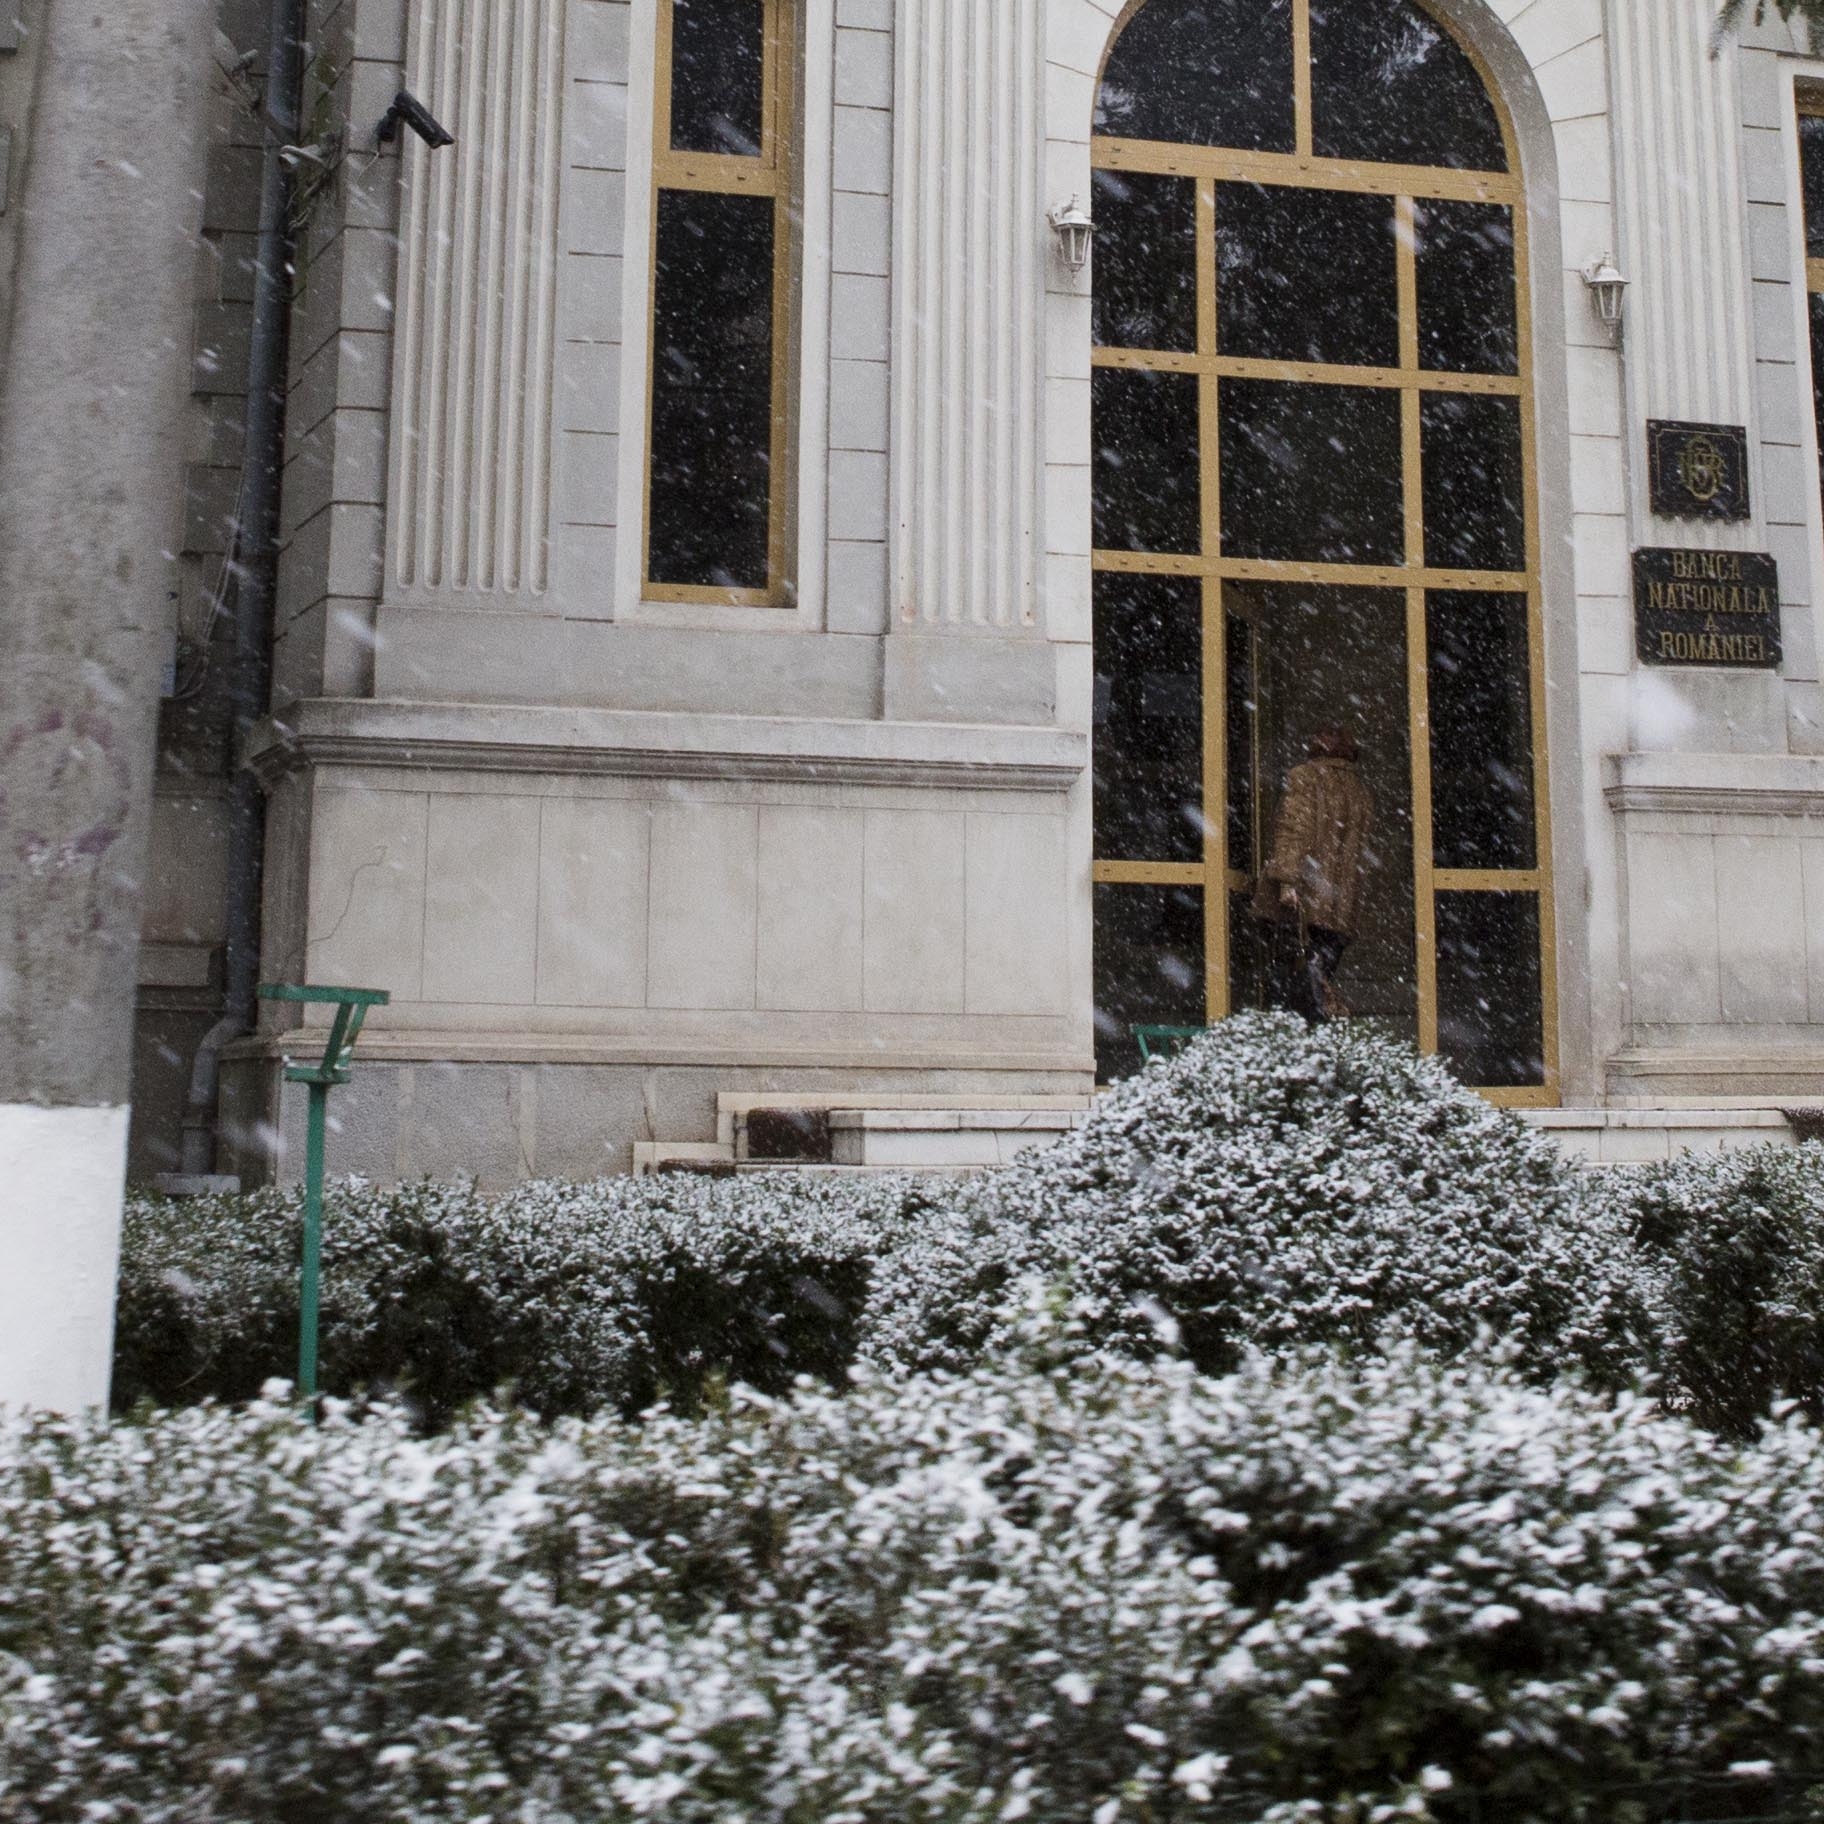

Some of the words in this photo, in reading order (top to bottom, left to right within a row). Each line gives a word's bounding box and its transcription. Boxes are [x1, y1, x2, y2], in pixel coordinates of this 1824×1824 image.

[1672, 552, 1743, 580] BANCA
[1648, 582, 1770, 613] NATIONALA
[1703, 613, 1720, 631] A
